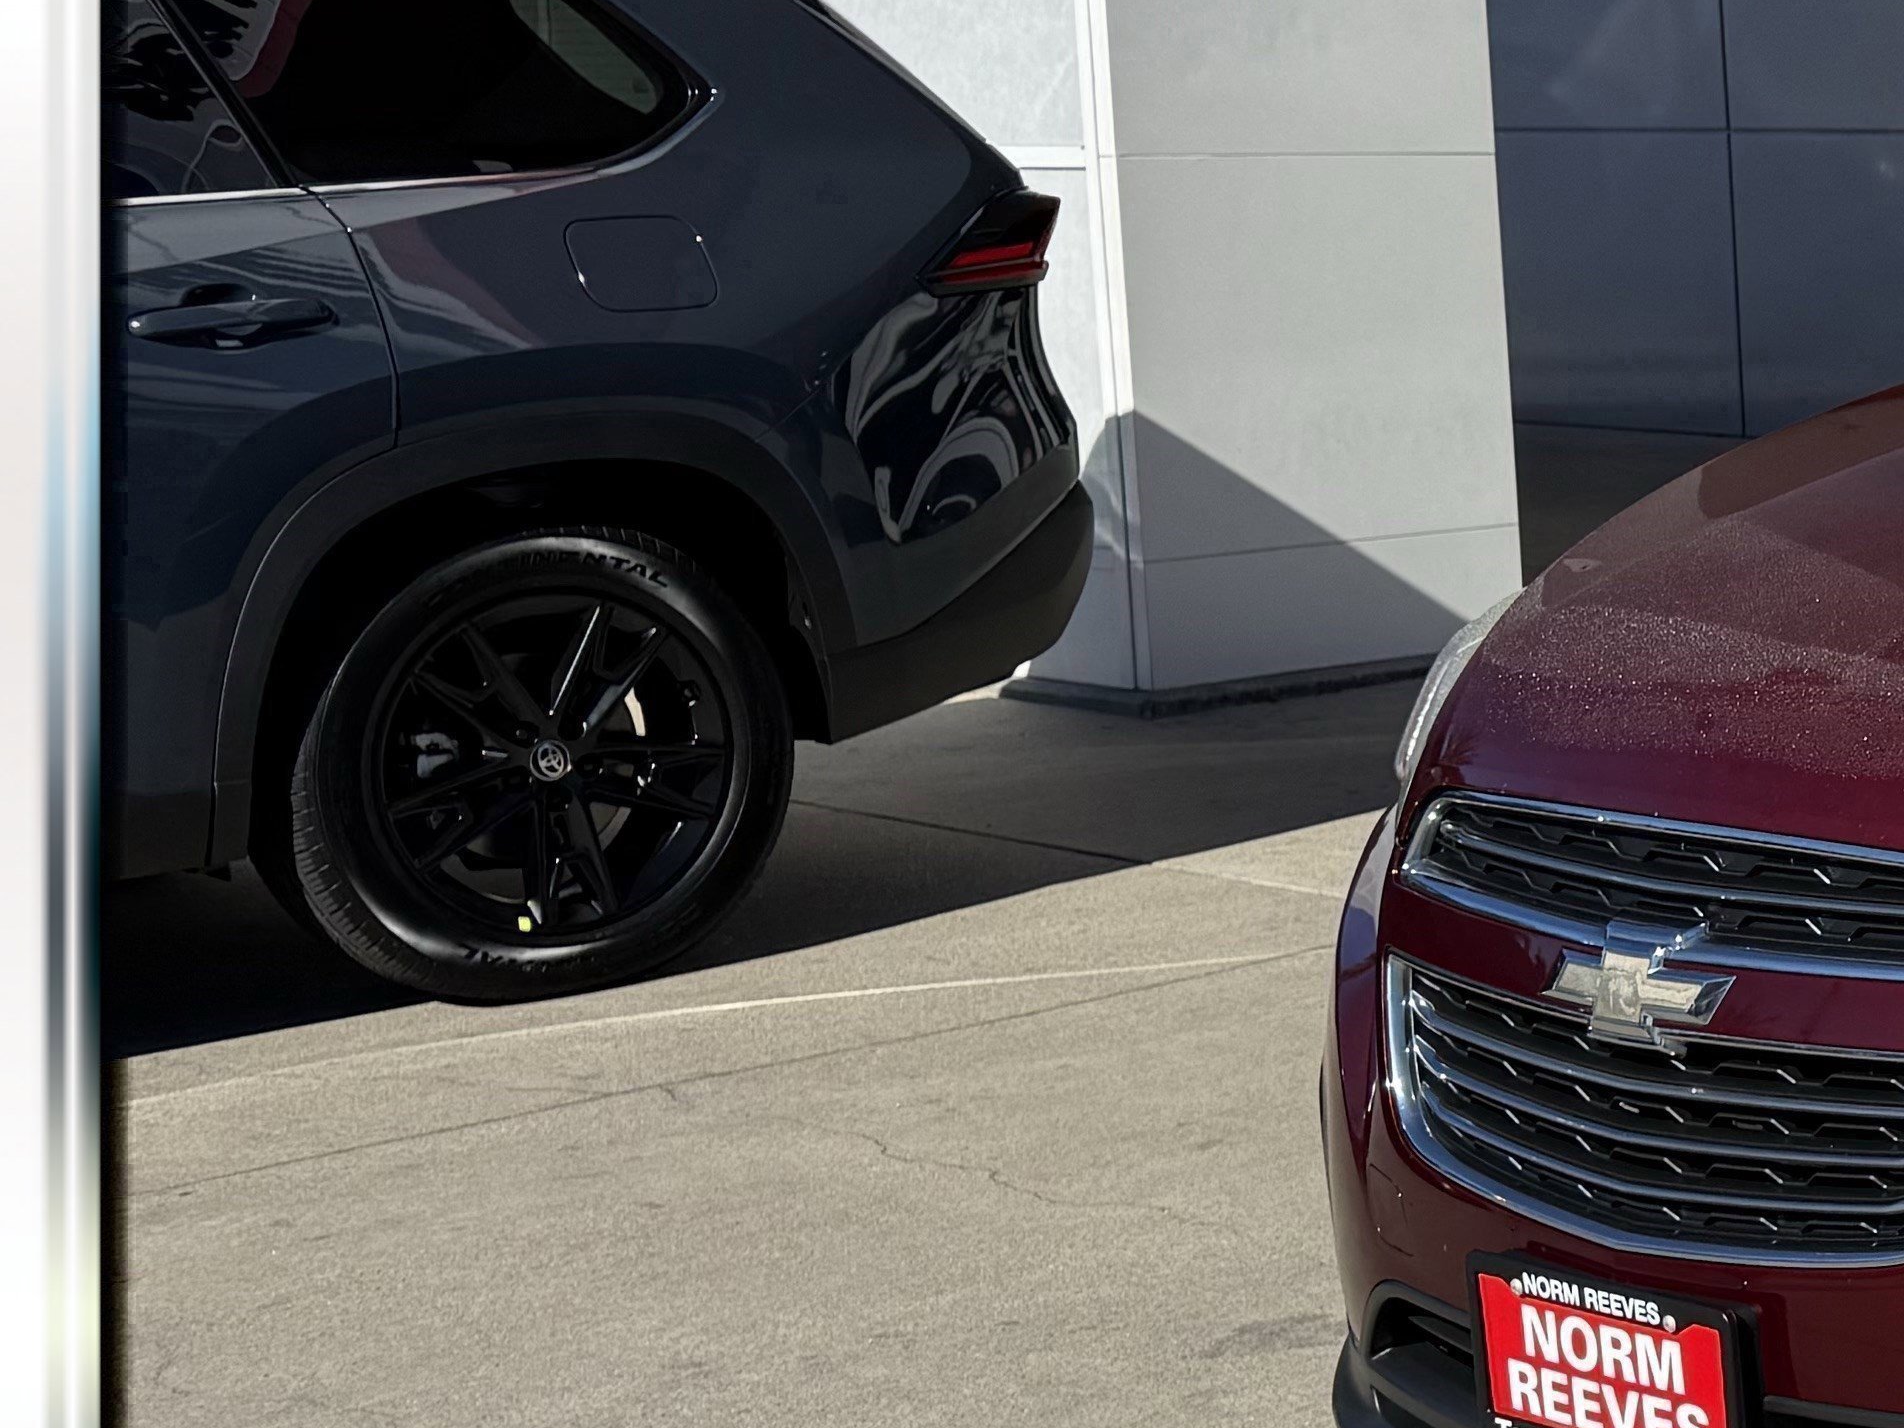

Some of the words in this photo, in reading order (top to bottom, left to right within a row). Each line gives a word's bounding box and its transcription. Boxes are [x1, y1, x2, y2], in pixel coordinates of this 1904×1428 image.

[1521, 1271, 1580, 1307] NORM
[1583, 1287, 1661, 1325] REEVES
[1520, 1303, 1686, 1396] NORM
